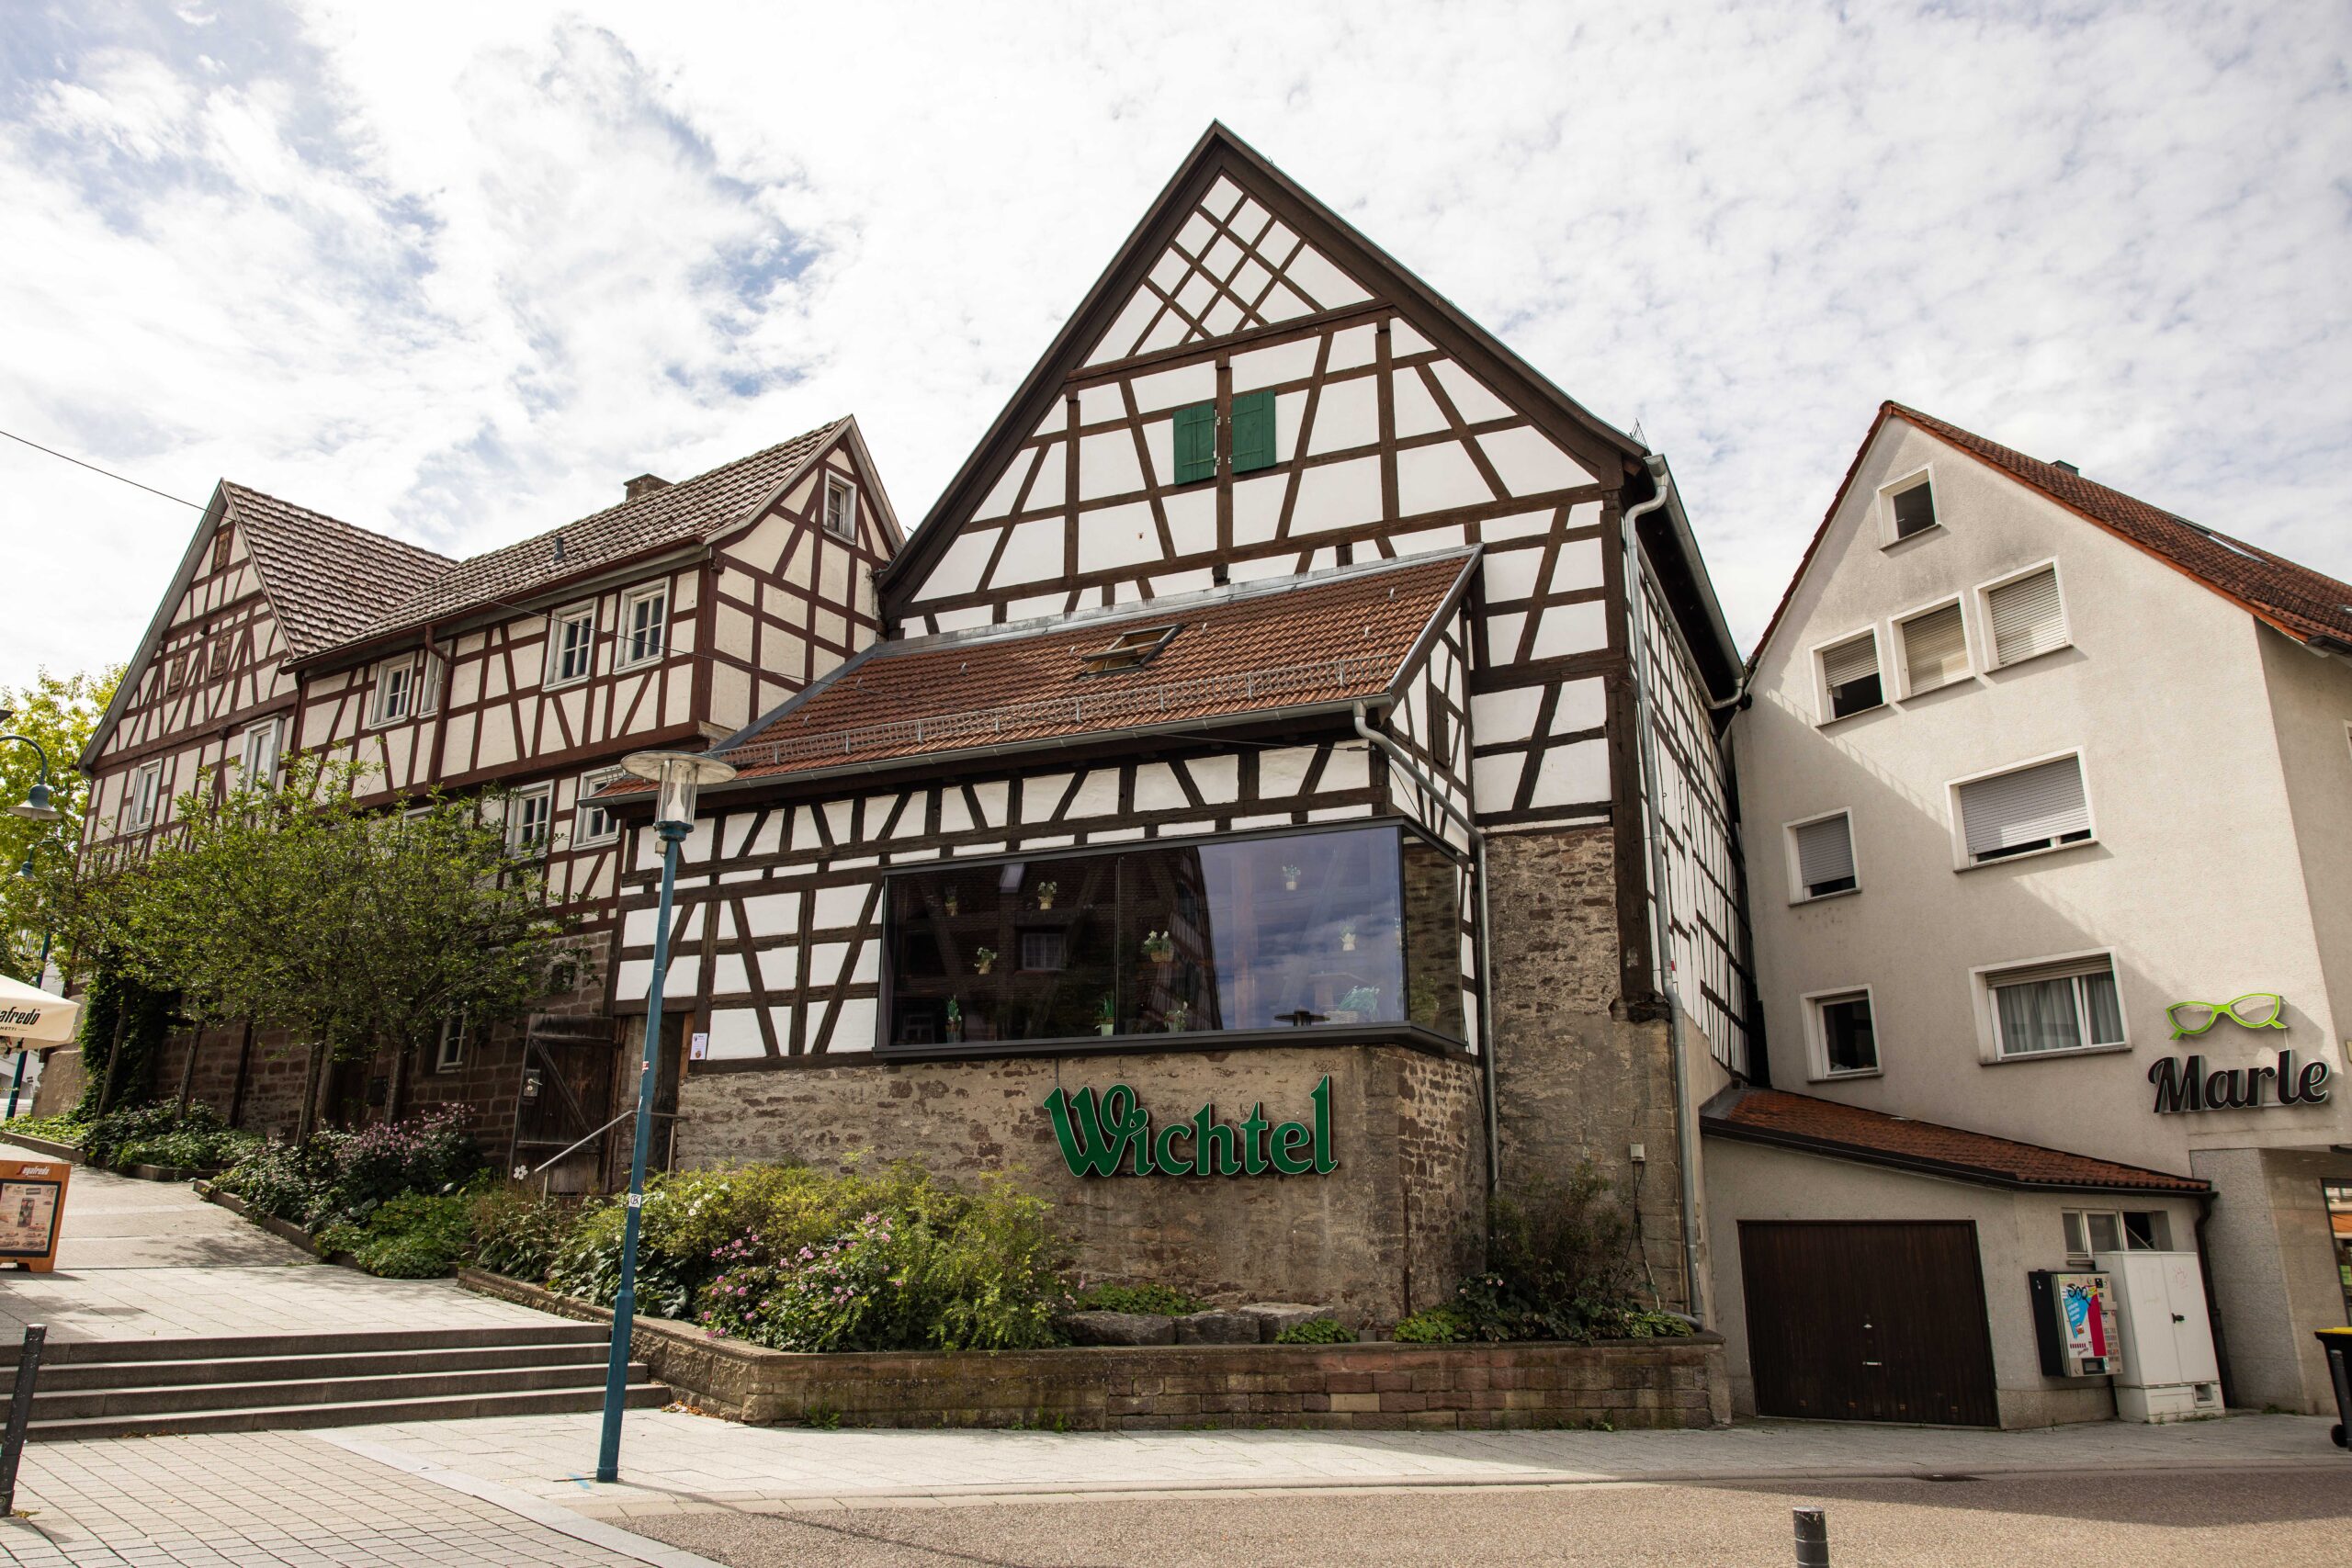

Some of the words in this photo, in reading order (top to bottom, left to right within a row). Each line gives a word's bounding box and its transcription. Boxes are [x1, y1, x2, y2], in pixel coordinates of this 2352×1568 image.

[0, 1007, 40, 1025] afredo
[2148, 1049, 2329, 1113] Marle
[1044, 1074, 1338, 1178] Wichtel
